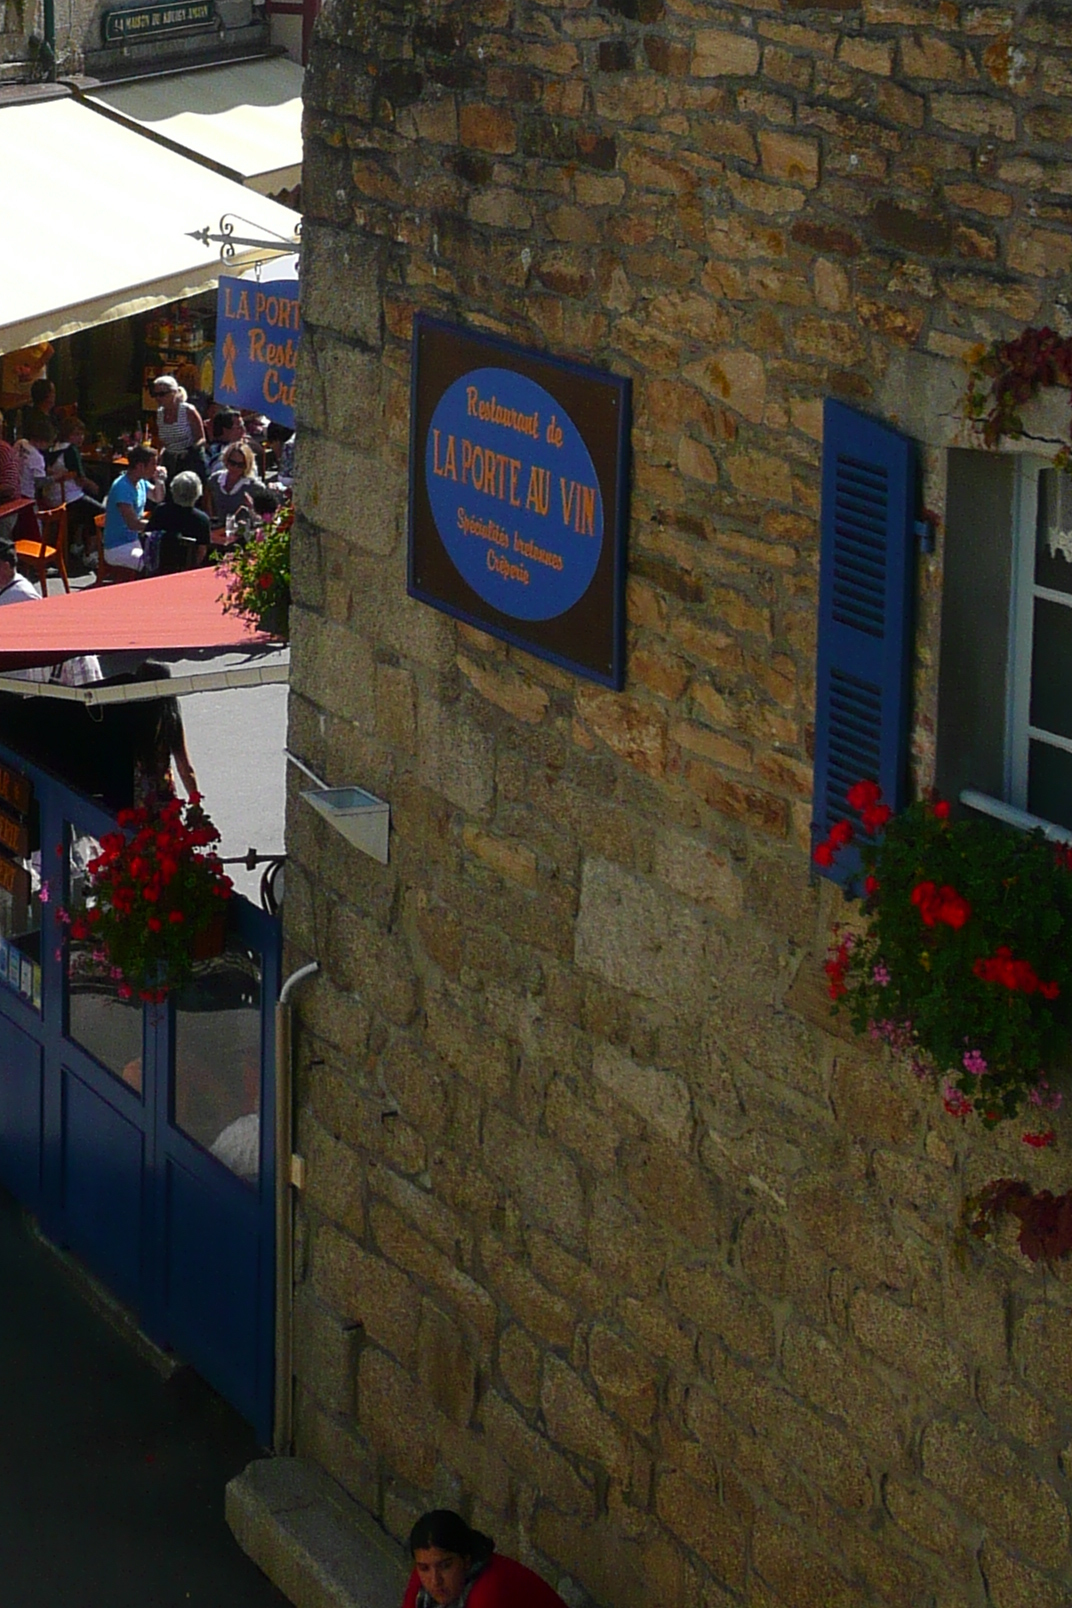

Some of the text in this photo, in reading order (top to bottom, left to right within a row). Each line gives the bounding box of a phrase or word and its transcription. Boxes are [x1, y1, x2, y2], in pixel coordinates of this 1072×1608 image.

[225, 287, 250, 321] LA
[466, 385, 564, 448] Restaurant de
[432, 428, 596, 537] LA PORTE AU VIN
[456, 506, 564, 572] Spécialités bretonnes
